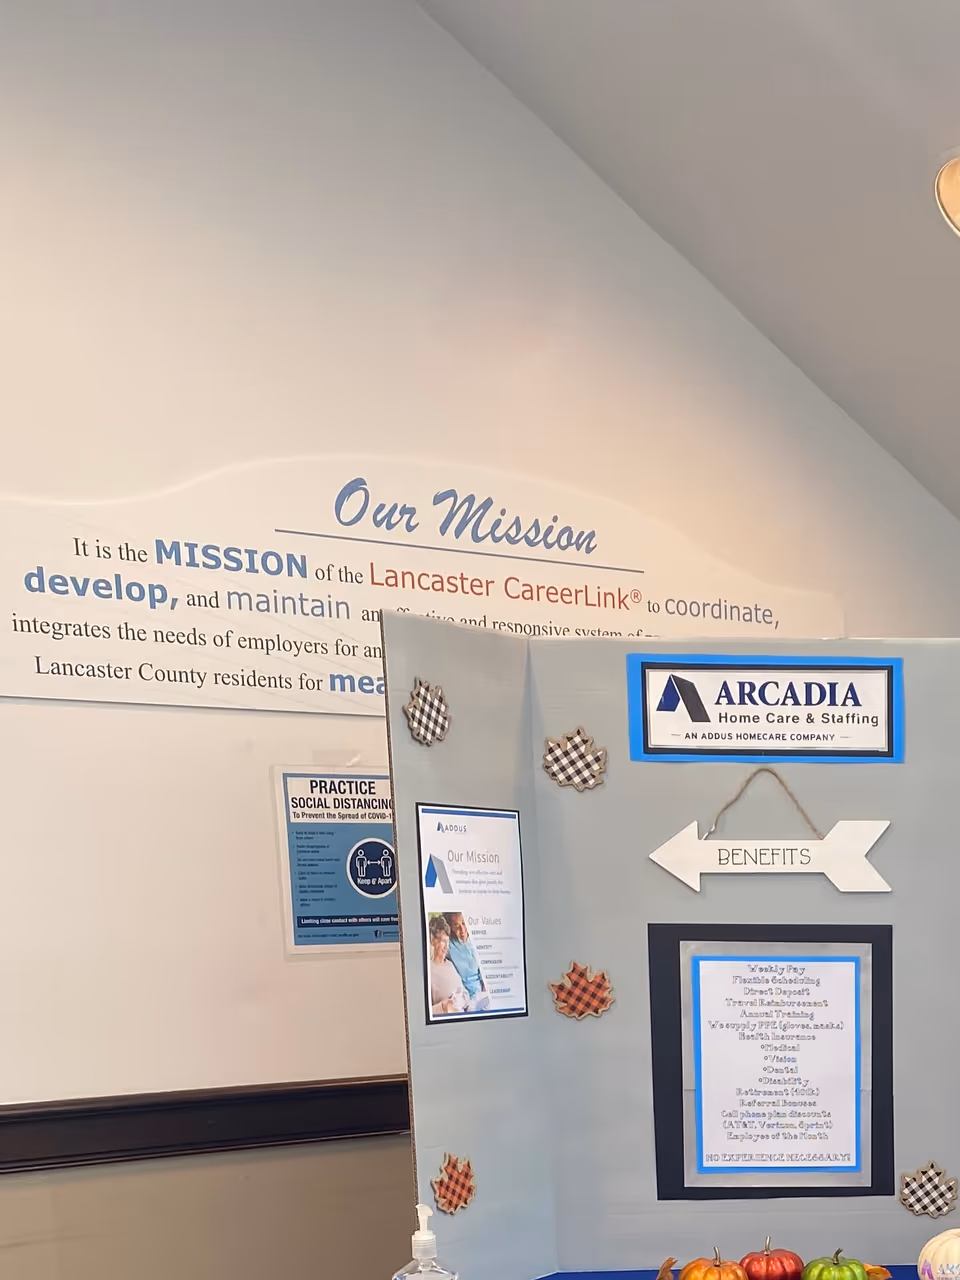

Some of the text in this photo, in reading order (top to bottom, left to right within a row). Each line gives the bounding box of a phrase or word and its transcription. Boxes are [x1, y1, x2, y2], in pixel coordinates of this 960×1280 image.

[335, 477, 597, 554] Our Mission
[73, 537, 89, 557] It
[96, 540, 111, 559] is
[118, 542, 148, 562] the
[155, 539, 307, 578] MISSION
[315, 564, 334, 582] of
[338, 566, 363, 584] the
[370, 562, 495, 597] Lancaster
[647, 600, 660, 614] to
[665, 597, 780, 629] coordinate,
[24, 566, 350, 619] develop, and maintain
[12, 613, 358, 658] integrates the needs of employers for
[34, 656, 385, 694] Lancaster County residents for mea
[714, 680, 862, 707] ARCADIA
[718, 712, 879, 727] Home Care & Staffing
[736, 733, 787, 741] HOMECARE
[790, 733, 835, 741] COMPANY
[309, 780, 376, 795] PRACTICE
[291, 797, 330, 809] SOCIAL
[293, 811, 300, 819] To
[301, 811, 325, 819] Prevent
[337, 812, 359, 820] Spread
[447, 850, 500, 864] Our Mission
[718, 848, 812, 865] BENEFITS
[377, 877, 392, 885] Apart
[747, 964, 806, 975] Weekly Pay
[732, 975, 821, 987] Flexible Scheduling
[743, 987, 810, 998] Direct Deposit
[725, 998, 828, 1008] Travel Reimbursement
[740, 1009, 814, 1021] Annual Training
[708, 1021, 757, 1032] We supply
[738, 1032, 816, 1041] Health Insurance
[736, 1088, 789, 1096] Retirement
[739, 1099, 817, 1107] Referral Bonuses
[720, 1110, 832, 1120] Cell phone plan discounts
[726, 1132, 829, 1143] Employee of the Month
[705, 1153, 785, 1162] NO EXPERIENCE
